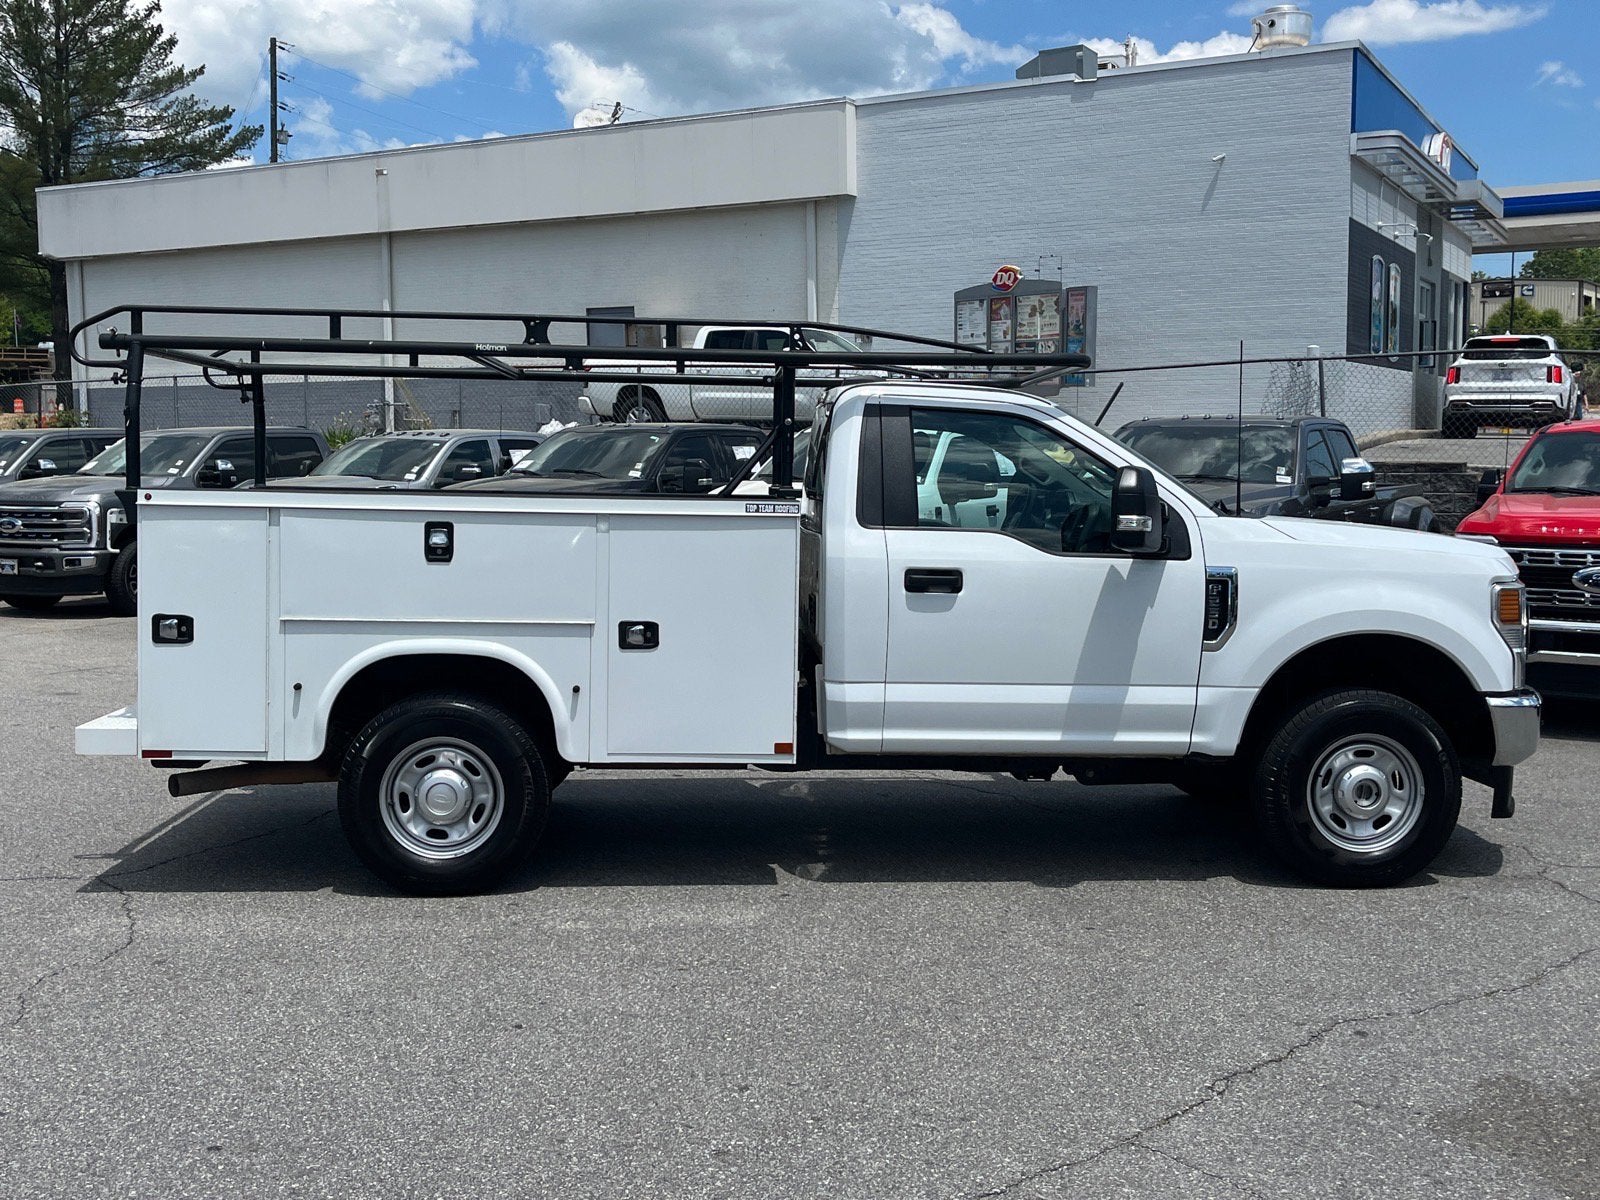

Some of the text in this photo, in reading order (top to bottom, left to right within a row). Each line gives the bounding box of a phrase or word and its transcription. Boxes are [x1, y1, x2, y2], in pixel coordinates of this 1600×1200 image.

[996, 271, 1015, 287] DQ
[475, 343, 508, 352] Holman
[746, 504, 799, 514] TOP TEAM ROOFING
